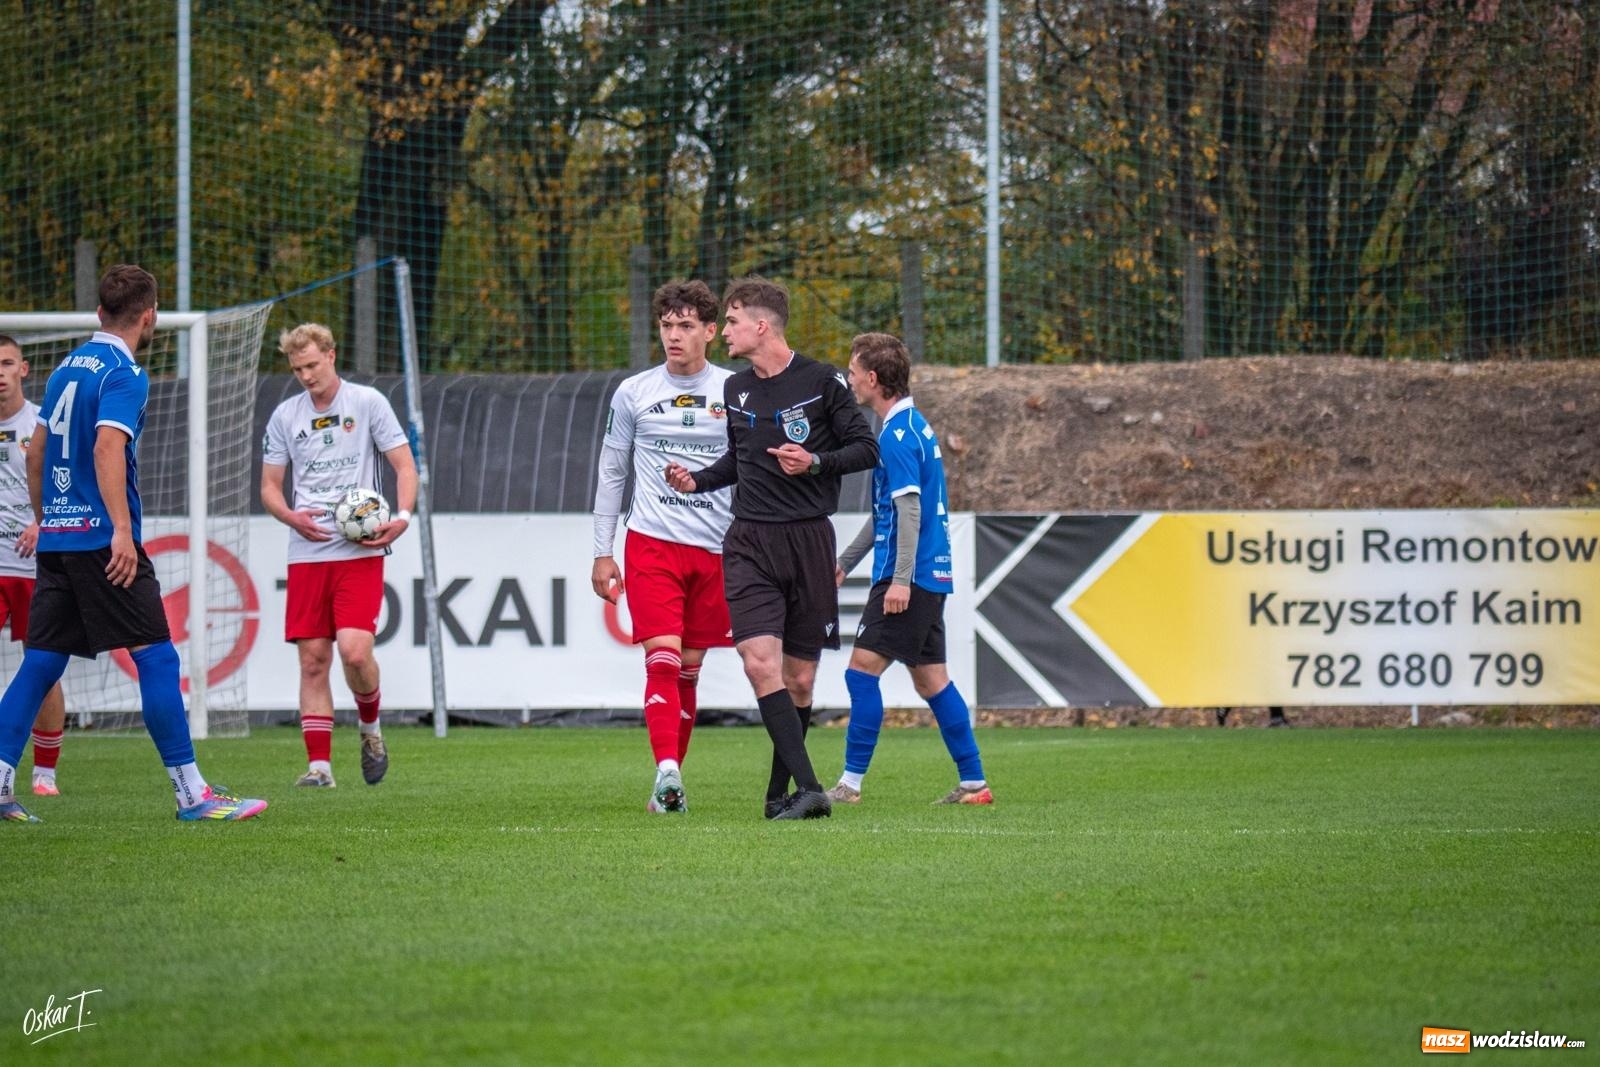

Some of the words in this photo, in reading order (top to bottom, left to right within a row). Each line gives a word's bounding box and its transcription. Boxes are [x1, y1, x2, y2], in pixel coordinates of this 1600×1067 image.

[48, 381, 78, 459] 4
[52, 496, 68, 505] MB
[659, 496, 714, 510] WENINGER
[1206, 529, 1345, 573] Usługi
[275, 578, 567, 647] KAI
[1249, 591, 1458, 634] Krzysztof
[1472, 591, 1583, 625] Kaim
[1286, 655, 1363, 688] 782
[1378, 653, 1453, 688] 680
[1469, 653, 1545, 688] 799
